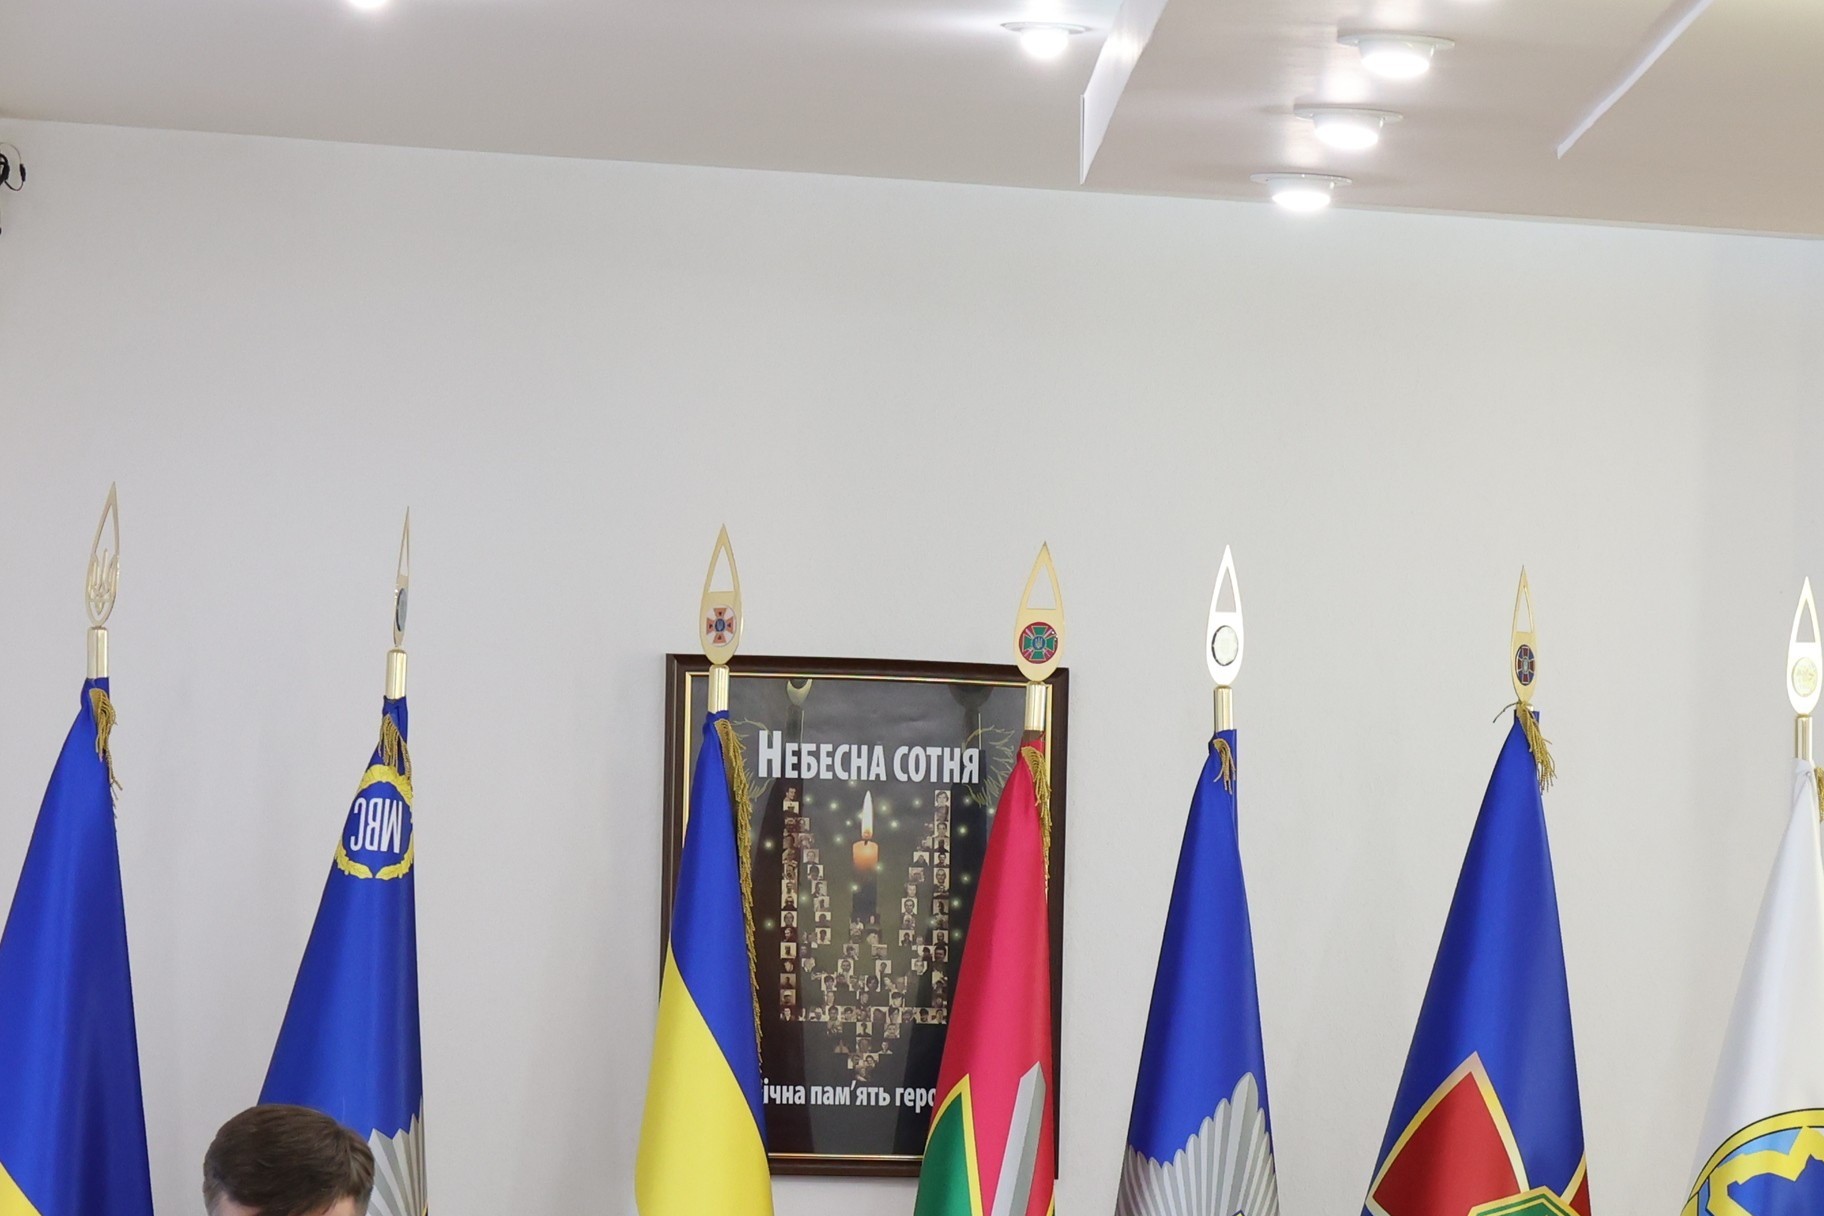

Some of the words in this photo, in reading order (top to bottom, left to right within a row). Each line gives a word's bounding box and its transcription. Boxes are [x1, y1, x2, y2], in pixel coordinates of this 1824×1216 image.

[758, 730, 887, 782] НЕБЕСНА
[893, 746, 980, 784] СОТНЯ
[349, 797, 403, 854] МВС
[762, 1077, 806, 1105] ічна
[895, 1086, 937, 1114] геро
